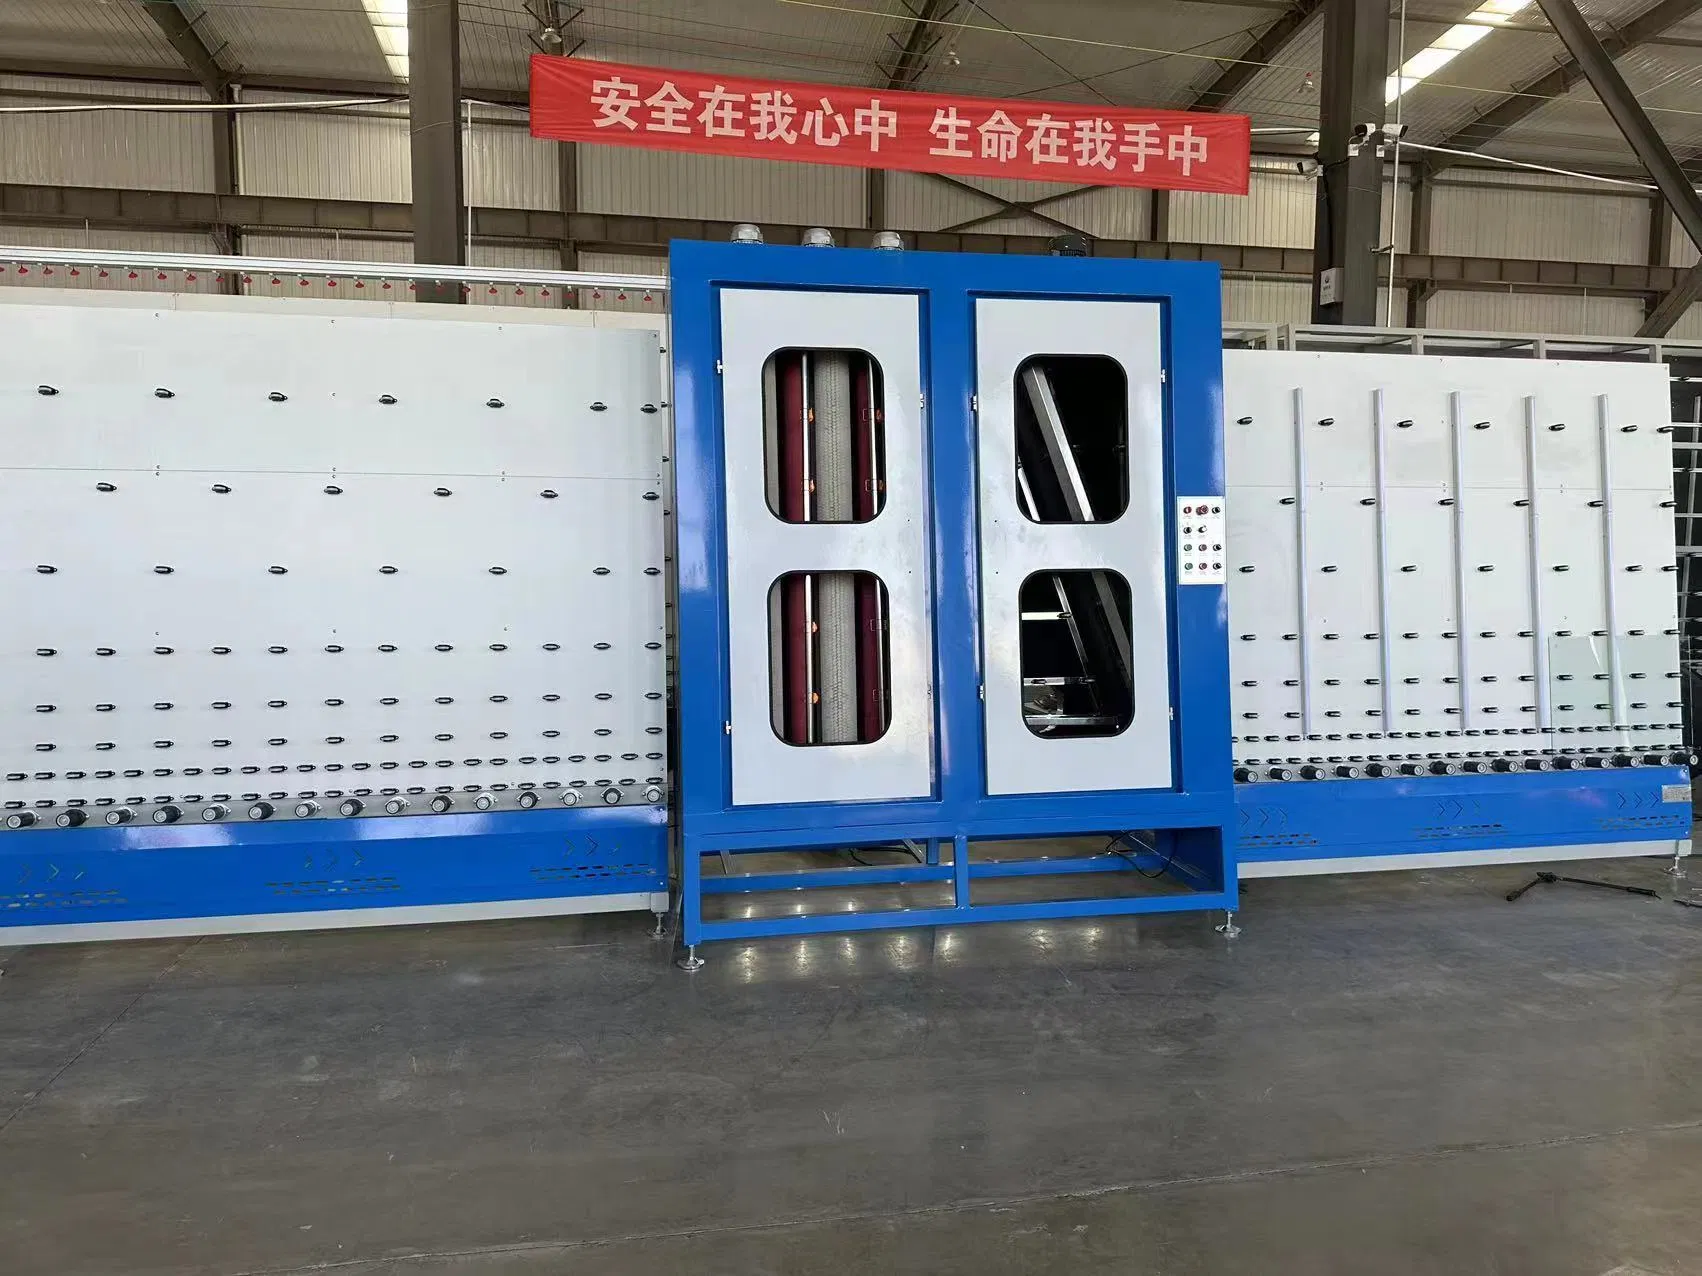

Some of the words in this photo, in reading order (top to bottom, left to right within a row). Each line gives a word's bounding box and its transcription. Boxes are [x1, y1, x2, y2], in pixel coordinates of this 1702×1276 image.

[591, 77, 898, 152] 安全在我心中
[929, 107, 1208, 177] 生命在我手中
